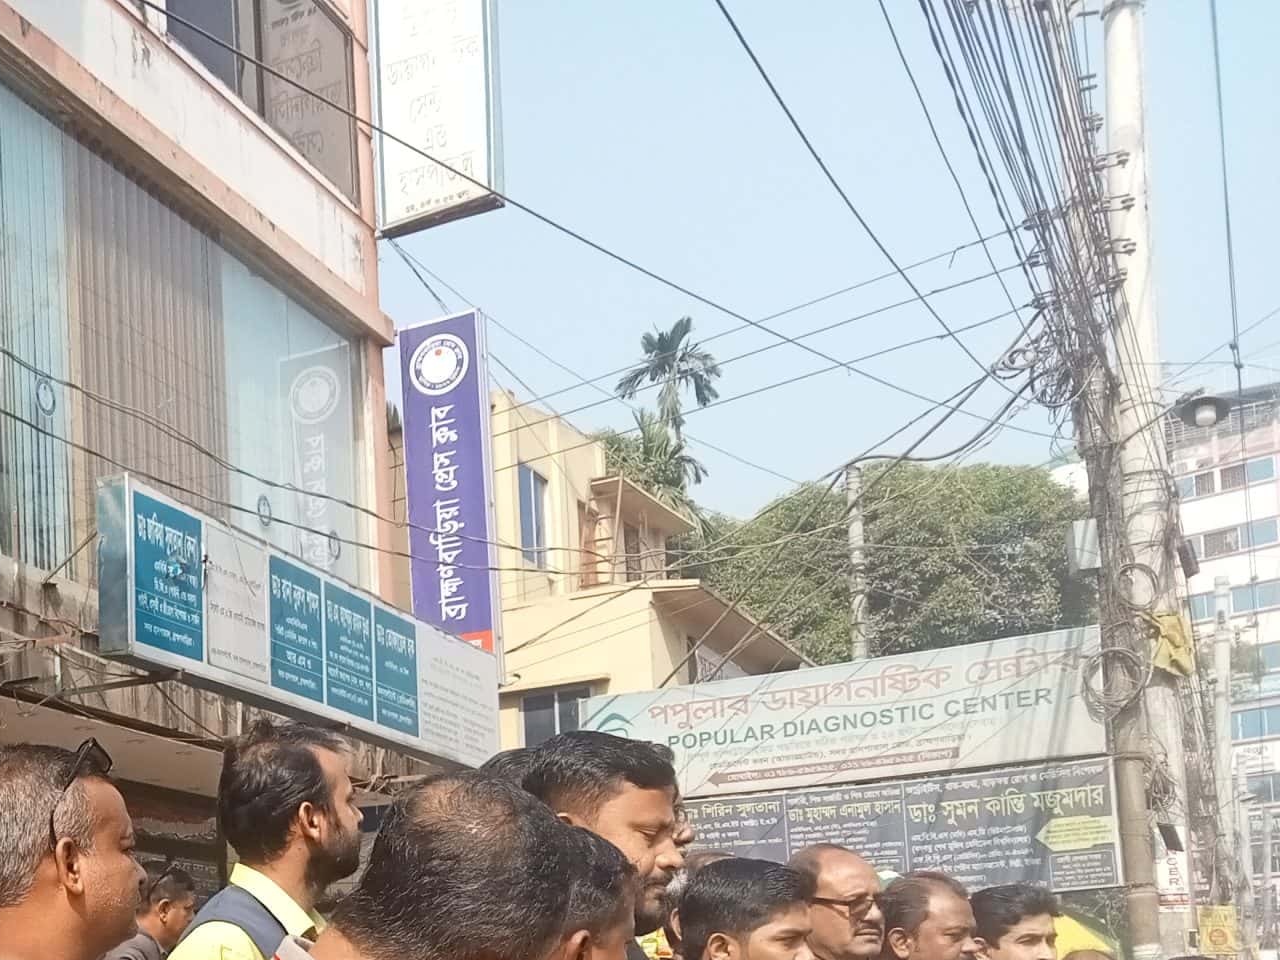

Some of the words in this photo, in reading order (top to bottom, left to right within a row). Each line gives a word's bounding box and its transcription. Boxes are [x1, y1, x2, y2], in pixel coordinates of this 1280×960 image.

[429, 403, 459, 448] ক্লাব
[432, 449, 460, 491] প্রেস
[647, 693, 751, 730] পপুলার
[667, 723, 777, 751] POPULAR
[783, 703, 935, 738] DIAGNOSTIC
[943, 688, 1053, 718] CENTER
[907, 801, 937, 825] ডাঃ
[939, 798, 981, 826] সুমন
[982, 787, 1027, 817] কান্তি
[1029, 784, 1106, 815] মজুমদার
